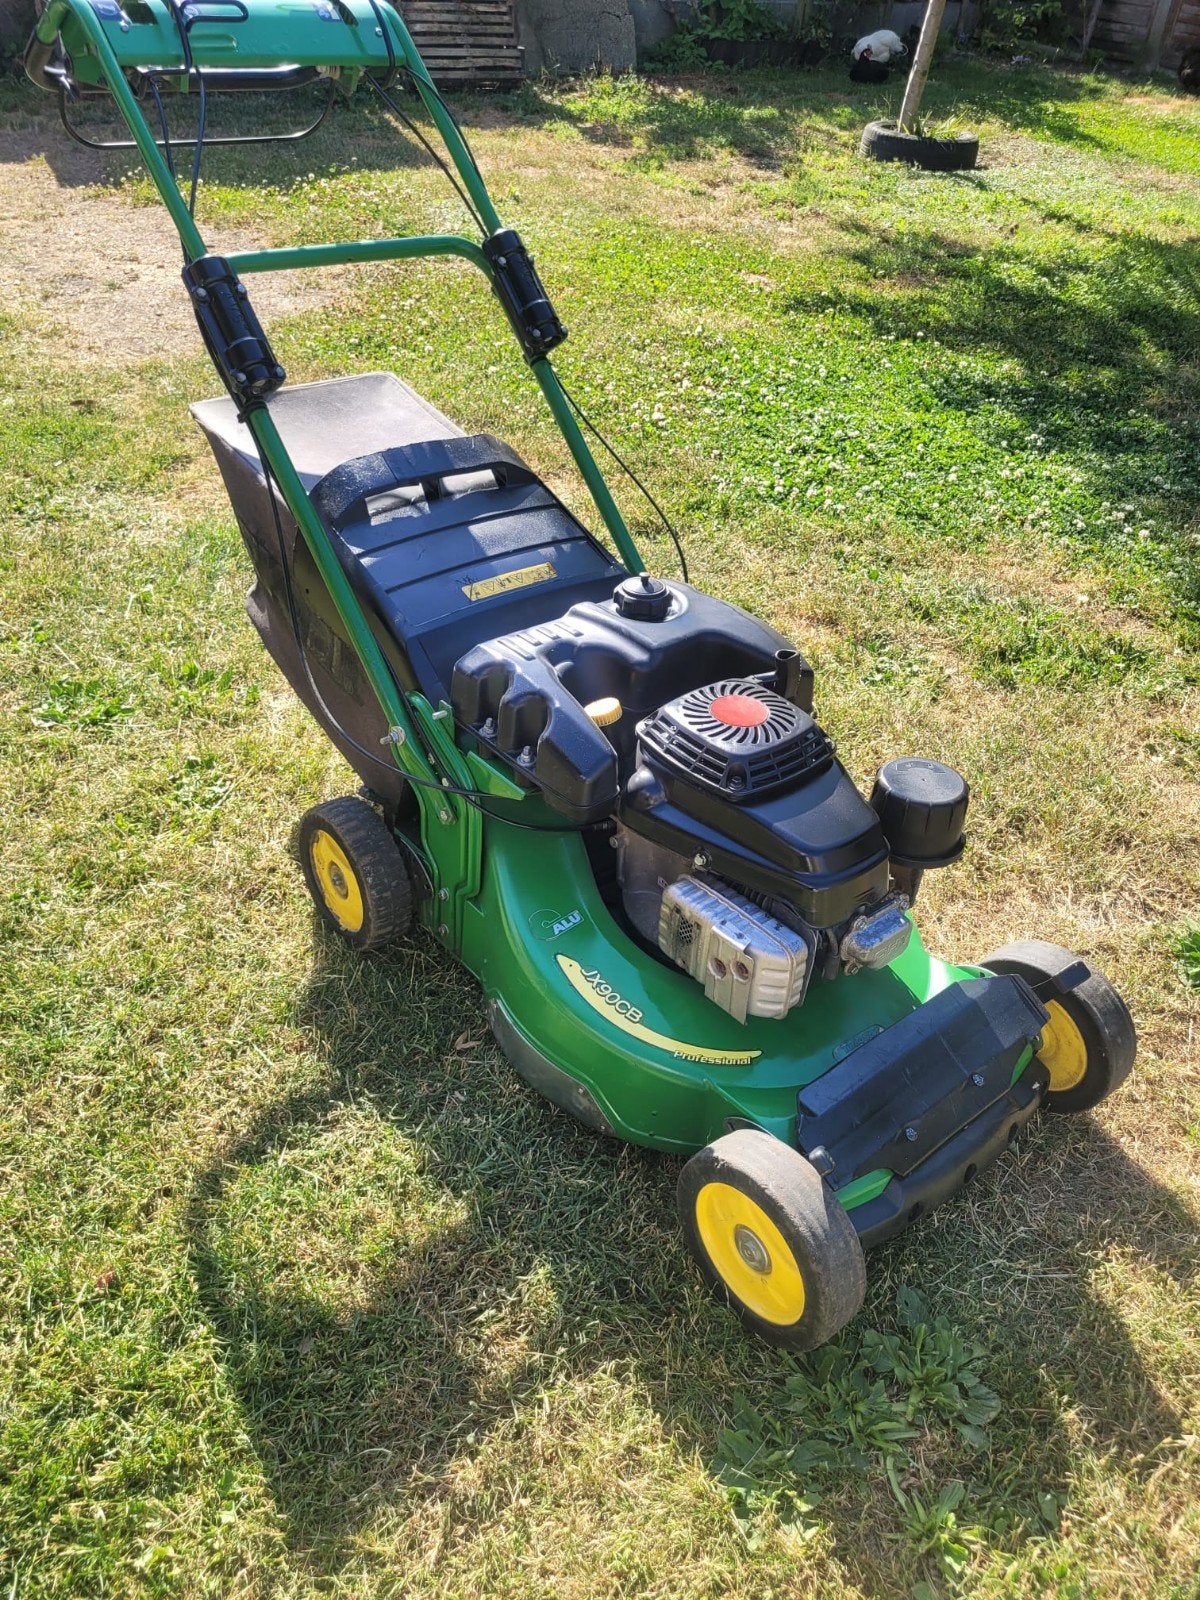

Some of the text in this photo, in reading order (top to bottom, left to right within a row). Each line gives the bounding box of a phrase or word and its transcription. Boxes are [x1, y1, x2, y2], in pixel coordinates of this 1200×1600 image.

[552, 911, 581, 935] ALU
[581, 968, 643, 1023] JX90CB
[673, 1050, 751, 1066] Professional
